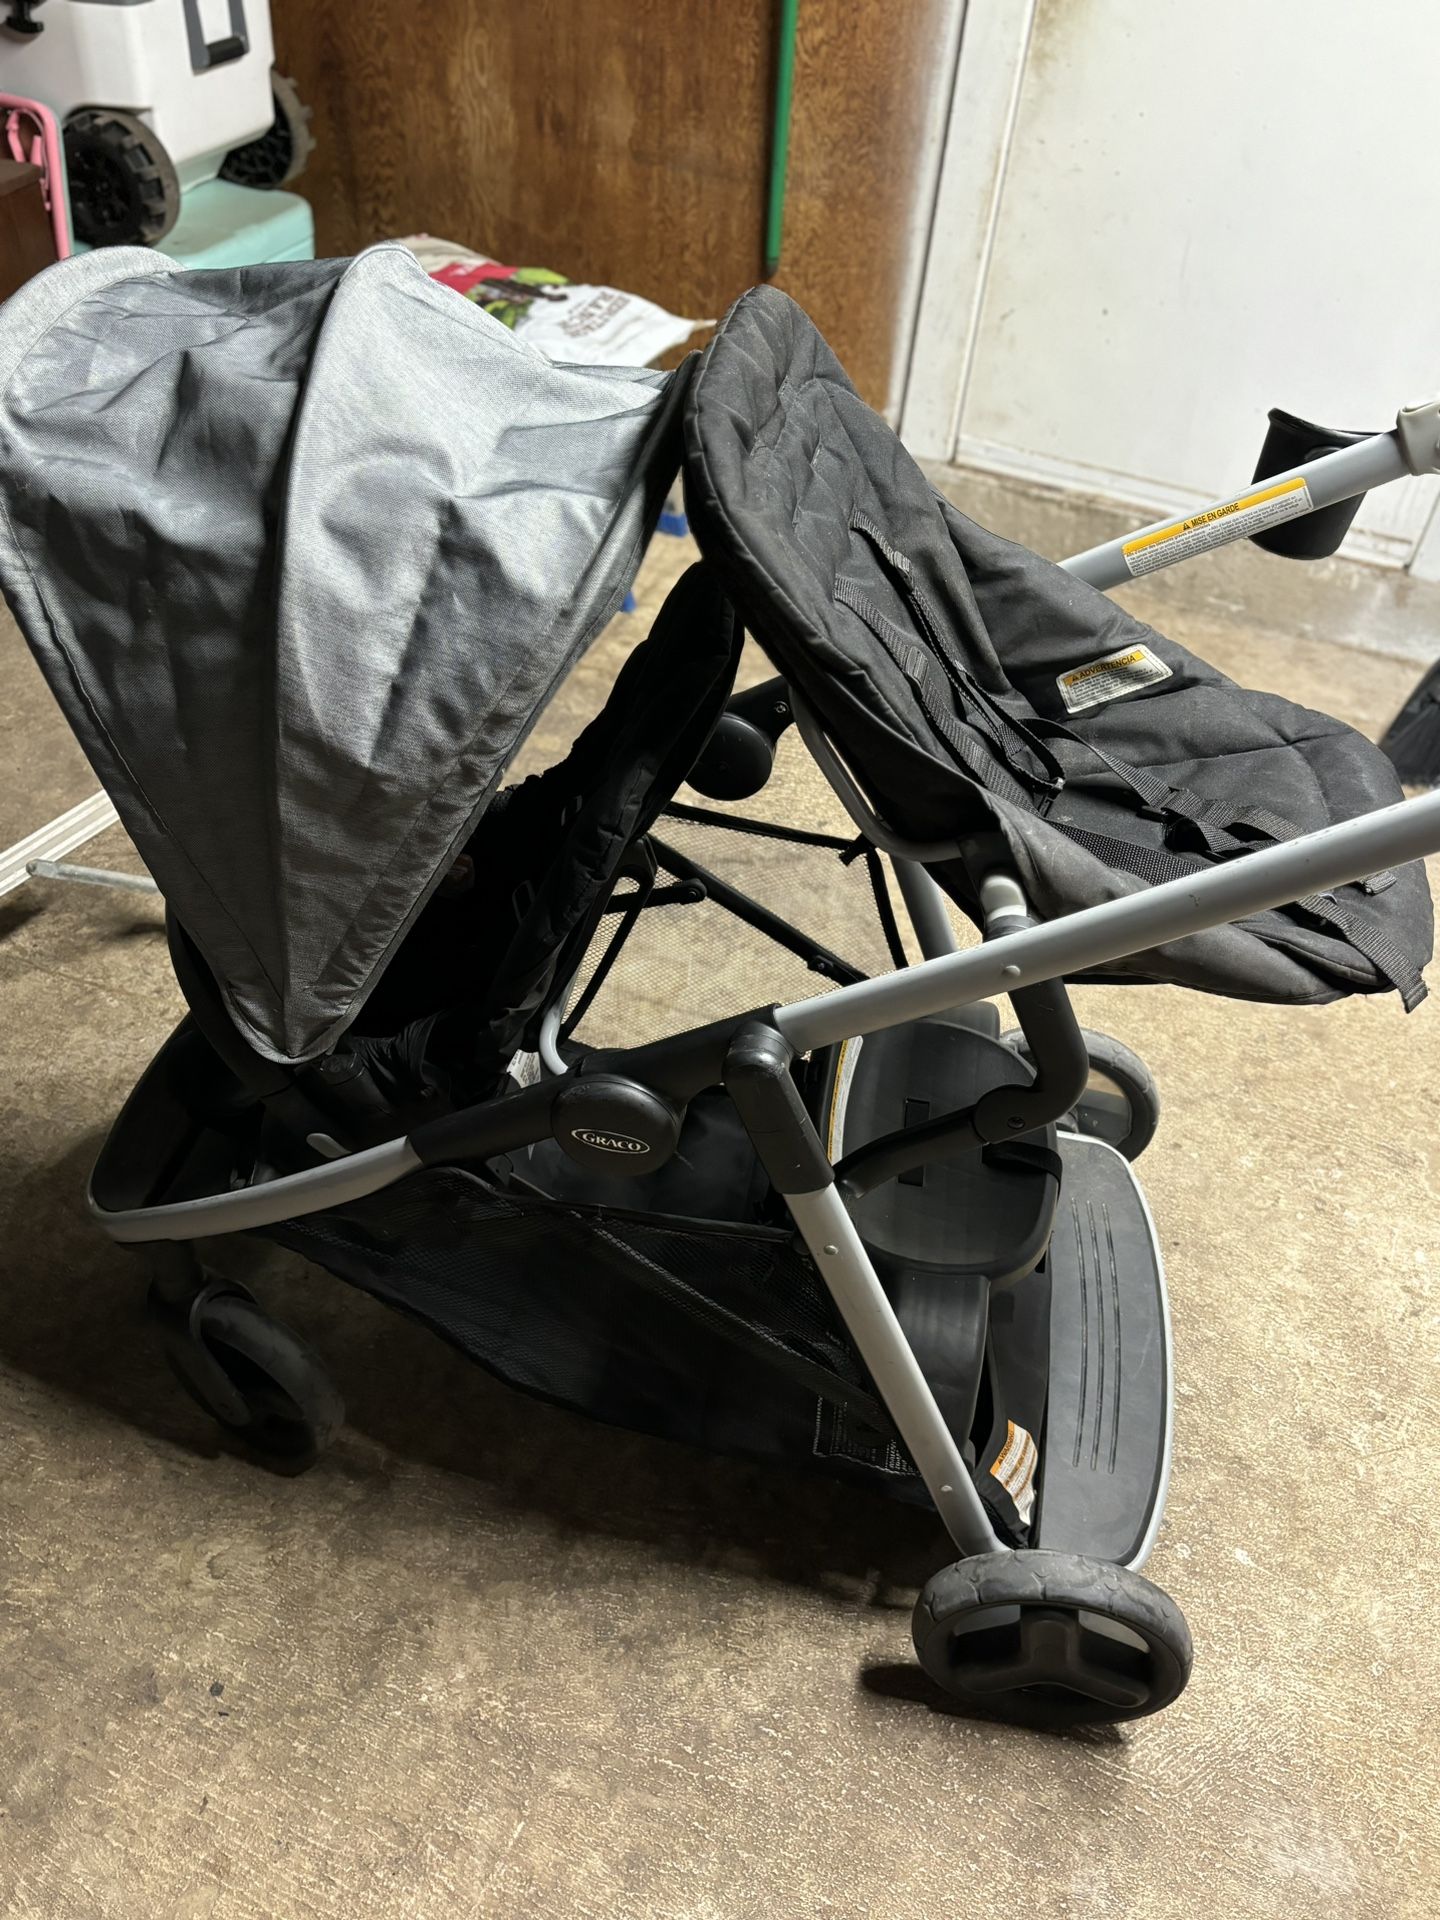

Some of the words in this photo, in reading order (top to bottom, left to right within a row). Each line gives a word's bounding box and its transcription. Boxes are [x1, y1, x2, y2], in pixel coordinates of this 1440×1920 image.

[1191, 514, 1207, 527] MISE
[1207, 511, 1217, 523] EN
[1217, 503, 1239, 517] GARDE
[1080, 655, 1136, 678] ADVERTENCIA
[582, 1132, 641, 1151] GRACO
